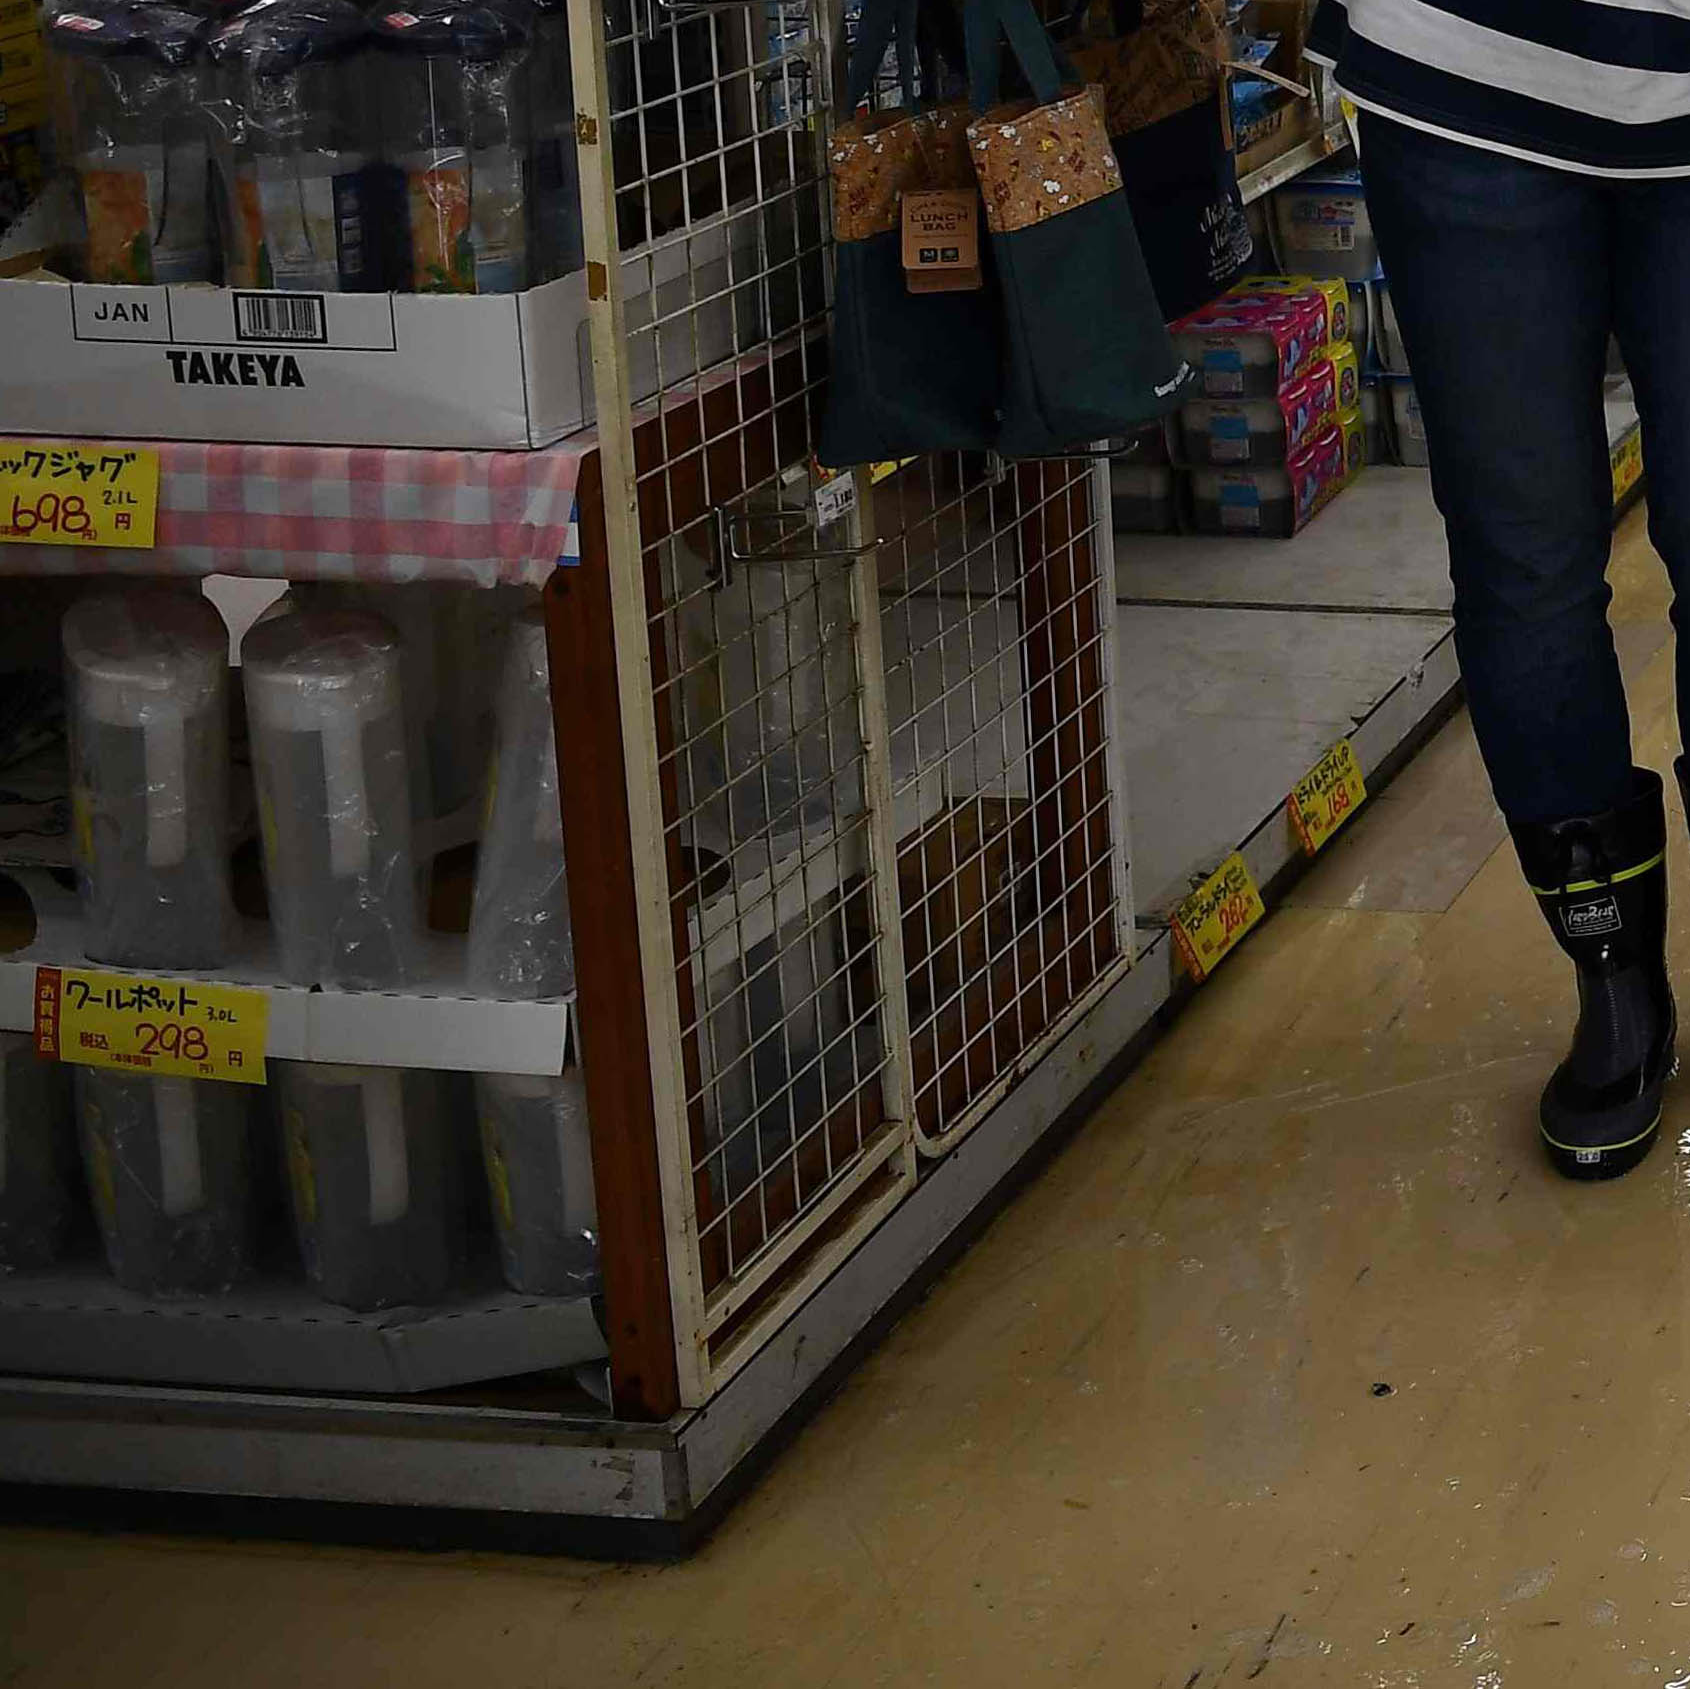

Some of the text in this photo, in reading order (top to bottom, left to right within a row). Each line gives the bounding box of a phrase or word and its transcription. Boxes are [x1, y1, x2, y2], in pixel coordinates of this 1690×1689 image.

[910, 211, 969, 223] LUNCH
[922, 221, 957, 232] BAG
[95, 302, 149, 324] JAN
[166, 350, 306, 388] TAKEYA
[12, 493, 91, 533] 698
[115, 512, 131, 529] 円
[134, 1022, 209, 1061] 298
[228, 1050, 243, 1067] 円
